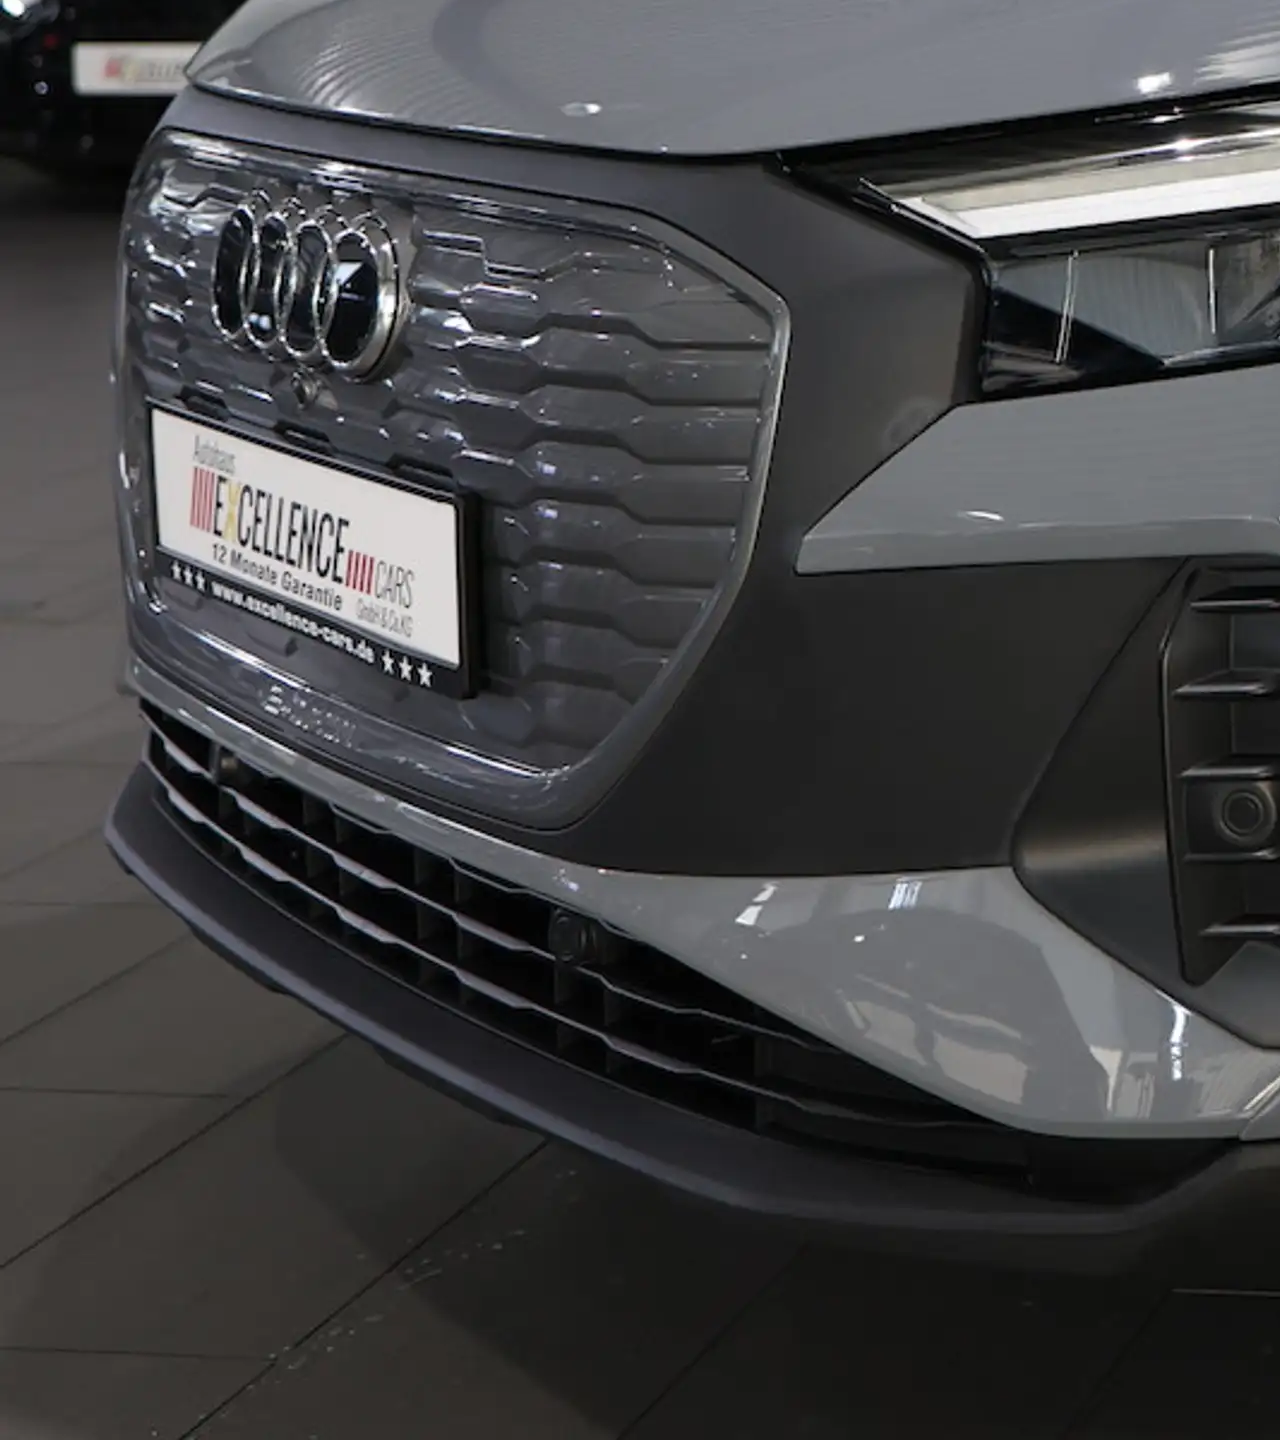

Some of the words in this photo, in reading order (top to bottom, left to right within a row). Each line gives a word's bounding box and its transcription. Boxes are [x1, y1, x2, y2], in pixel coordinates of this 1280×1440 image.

[212, 543, 227, 564] 12
[230, 549, 278, 586] Monate
[280, 570, 343, 611] Garantie
[213, 474, 350, 584] EXCELLENCE
[375, 560, 415, 610] CARS
[211, 580, 375, 664] www.excellence-cars.de
